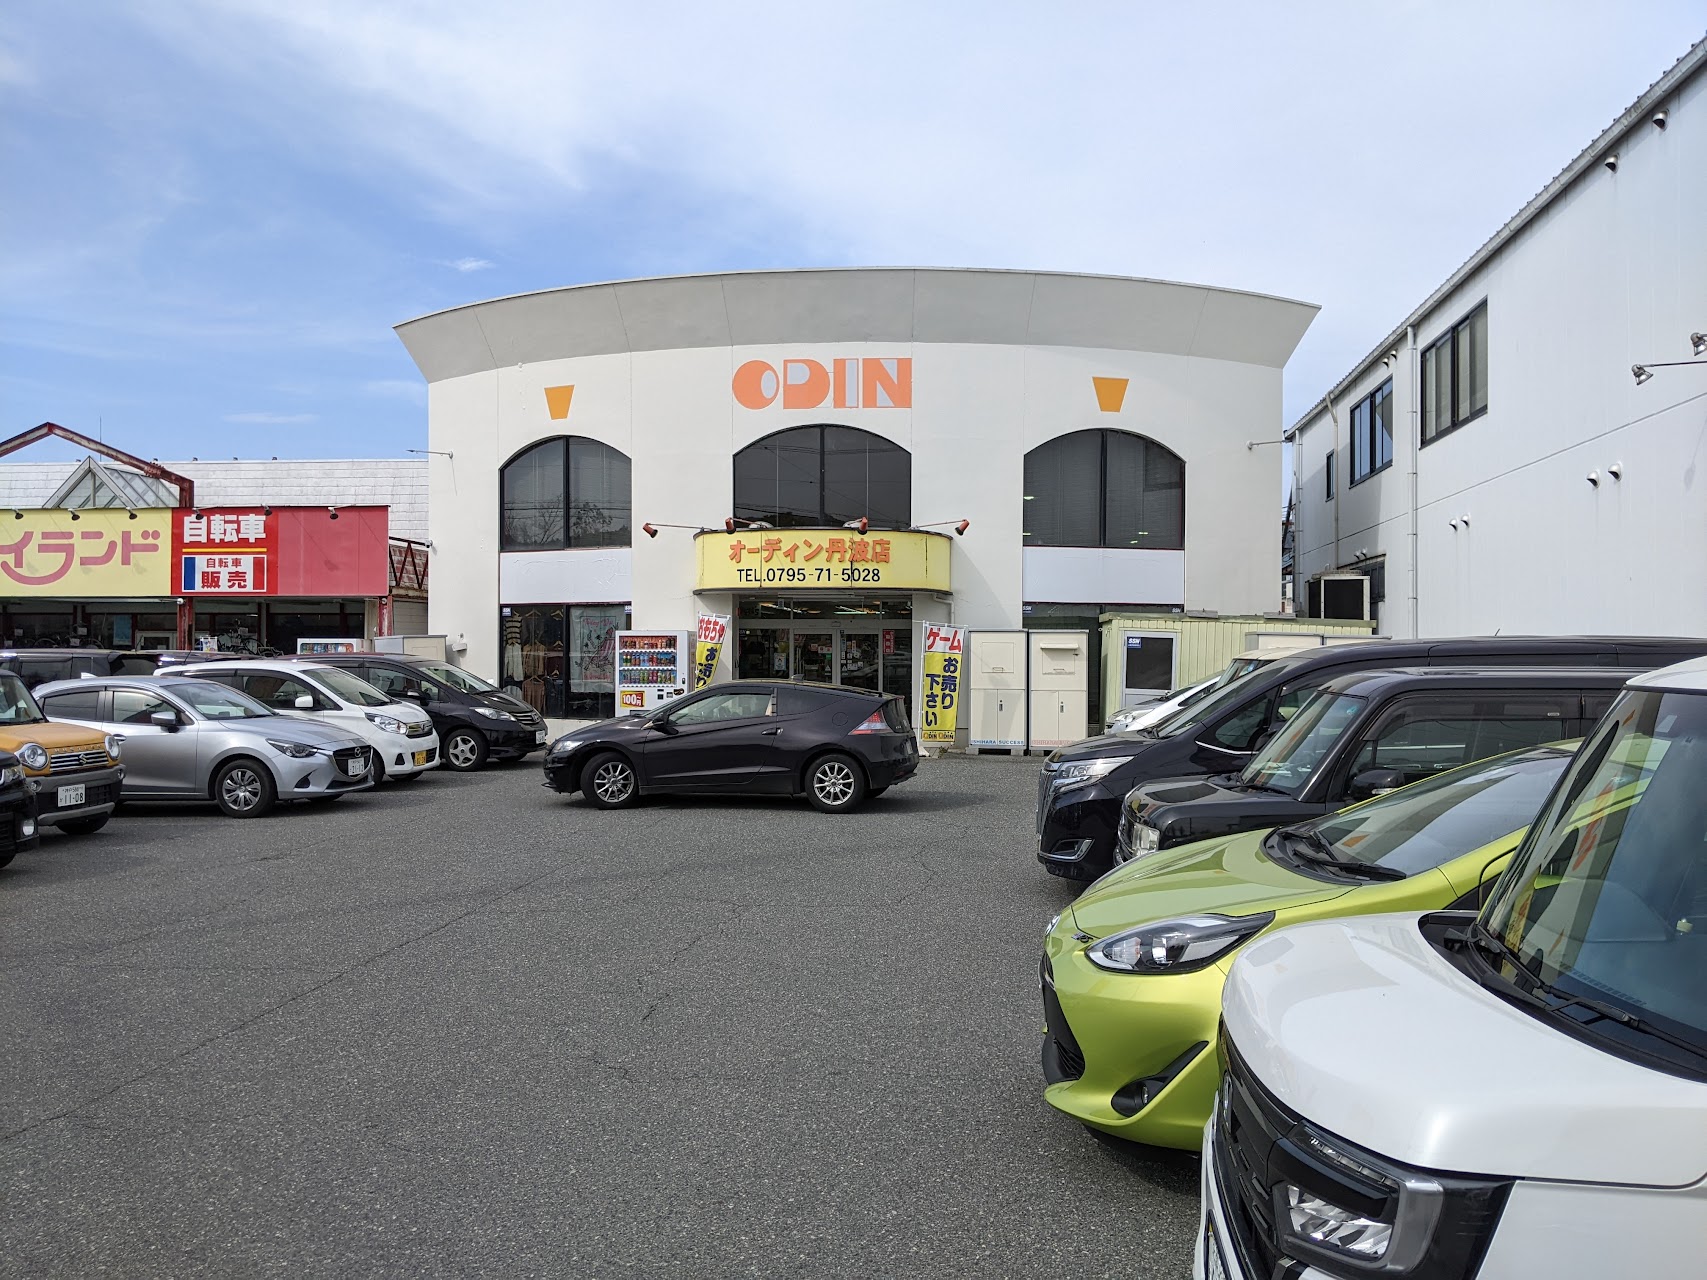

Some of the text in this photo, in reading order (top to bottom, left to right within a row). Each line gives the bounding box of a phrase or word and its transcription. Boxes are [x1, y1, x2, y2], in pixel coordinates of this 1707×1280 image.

[732, 357, 912, 410] ODIN
[183, 514, 266, 544] 自転車
[0, 530, 161, 585] イランド
[206, 557, 242, 569] 自転車
[728, 537, 891, 563] オーディン丹波店
[201, 570, 248, 589] 販売
[927, 628, 962, 652] ゲーム
[940, 656, 959, 710] お売り
[925, 673, 941, 727] 下さい
